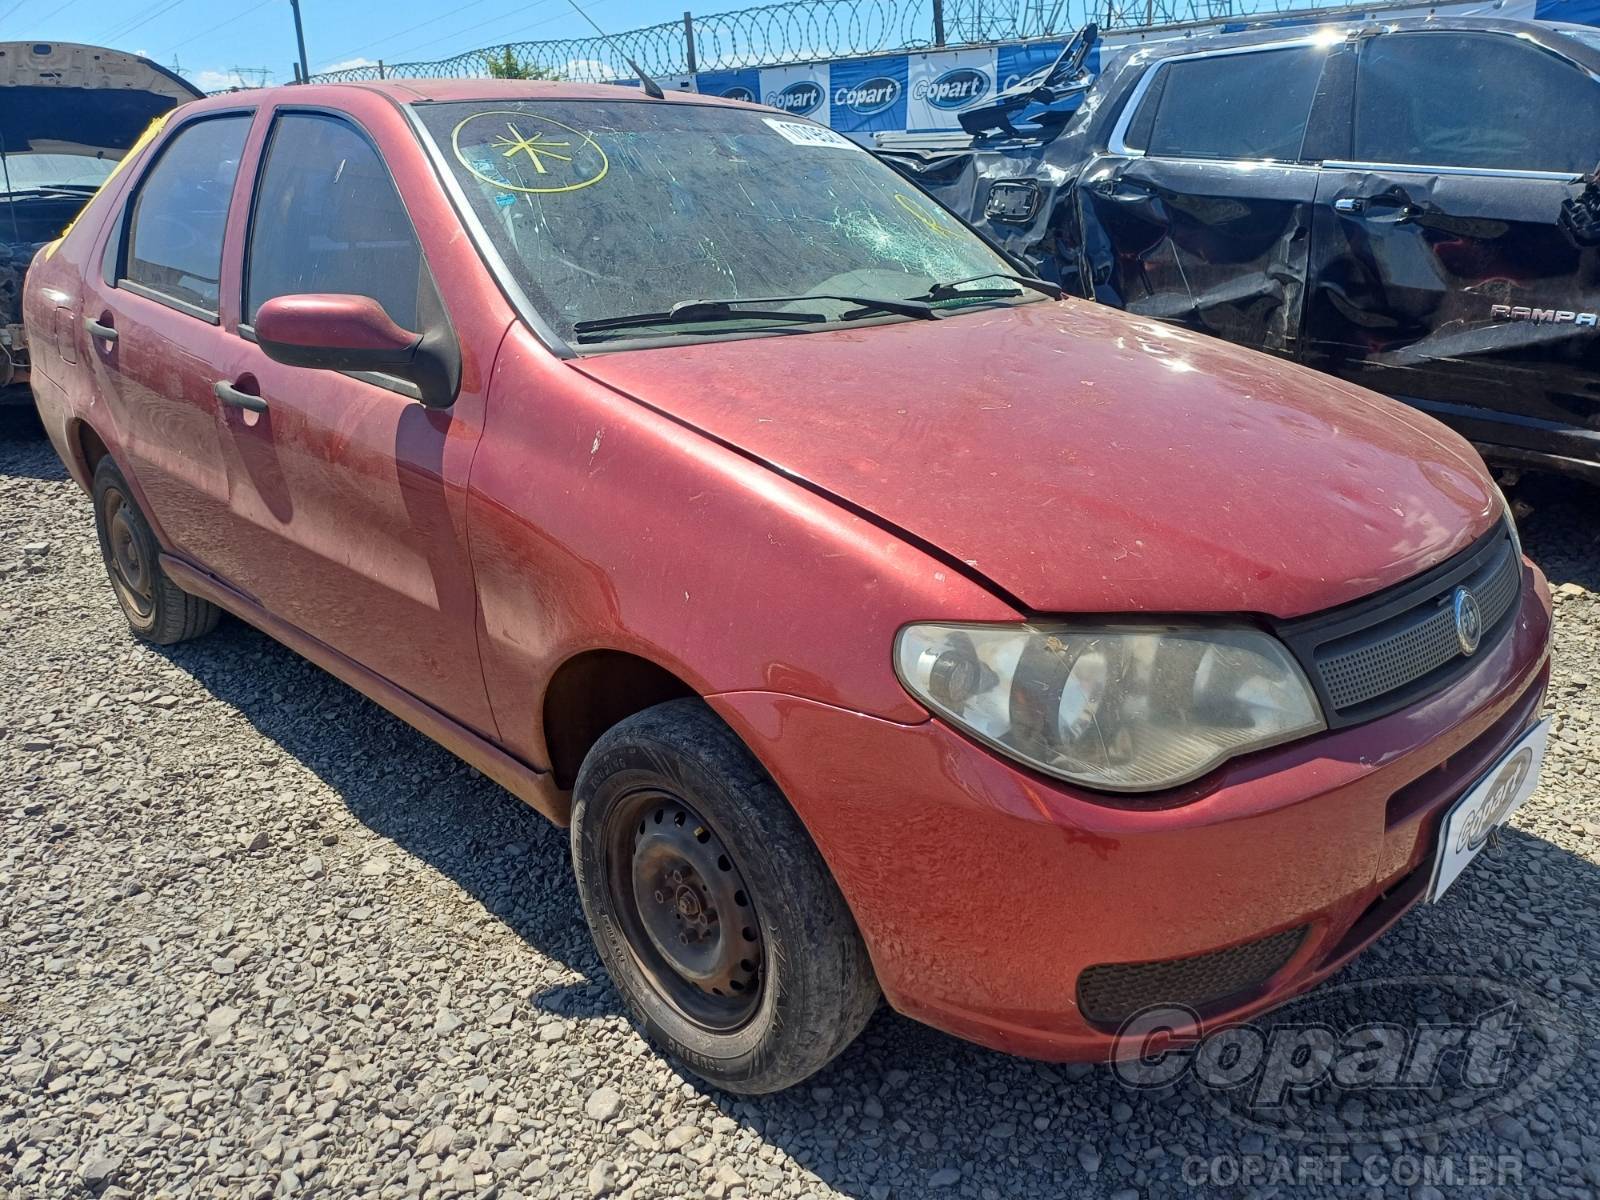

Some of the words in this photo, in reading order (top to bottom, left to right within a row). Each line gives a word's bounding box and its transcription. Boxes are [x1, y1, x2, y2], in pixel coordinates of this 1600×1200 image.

[766, 88, 817, 111] Copart
[834, 83, 894, 108] Copart
[913, 76, 980, 102] Copart
[1491, 304, 1600, 327] RAMPA
[1456, 761, 1522, 855] Copart
